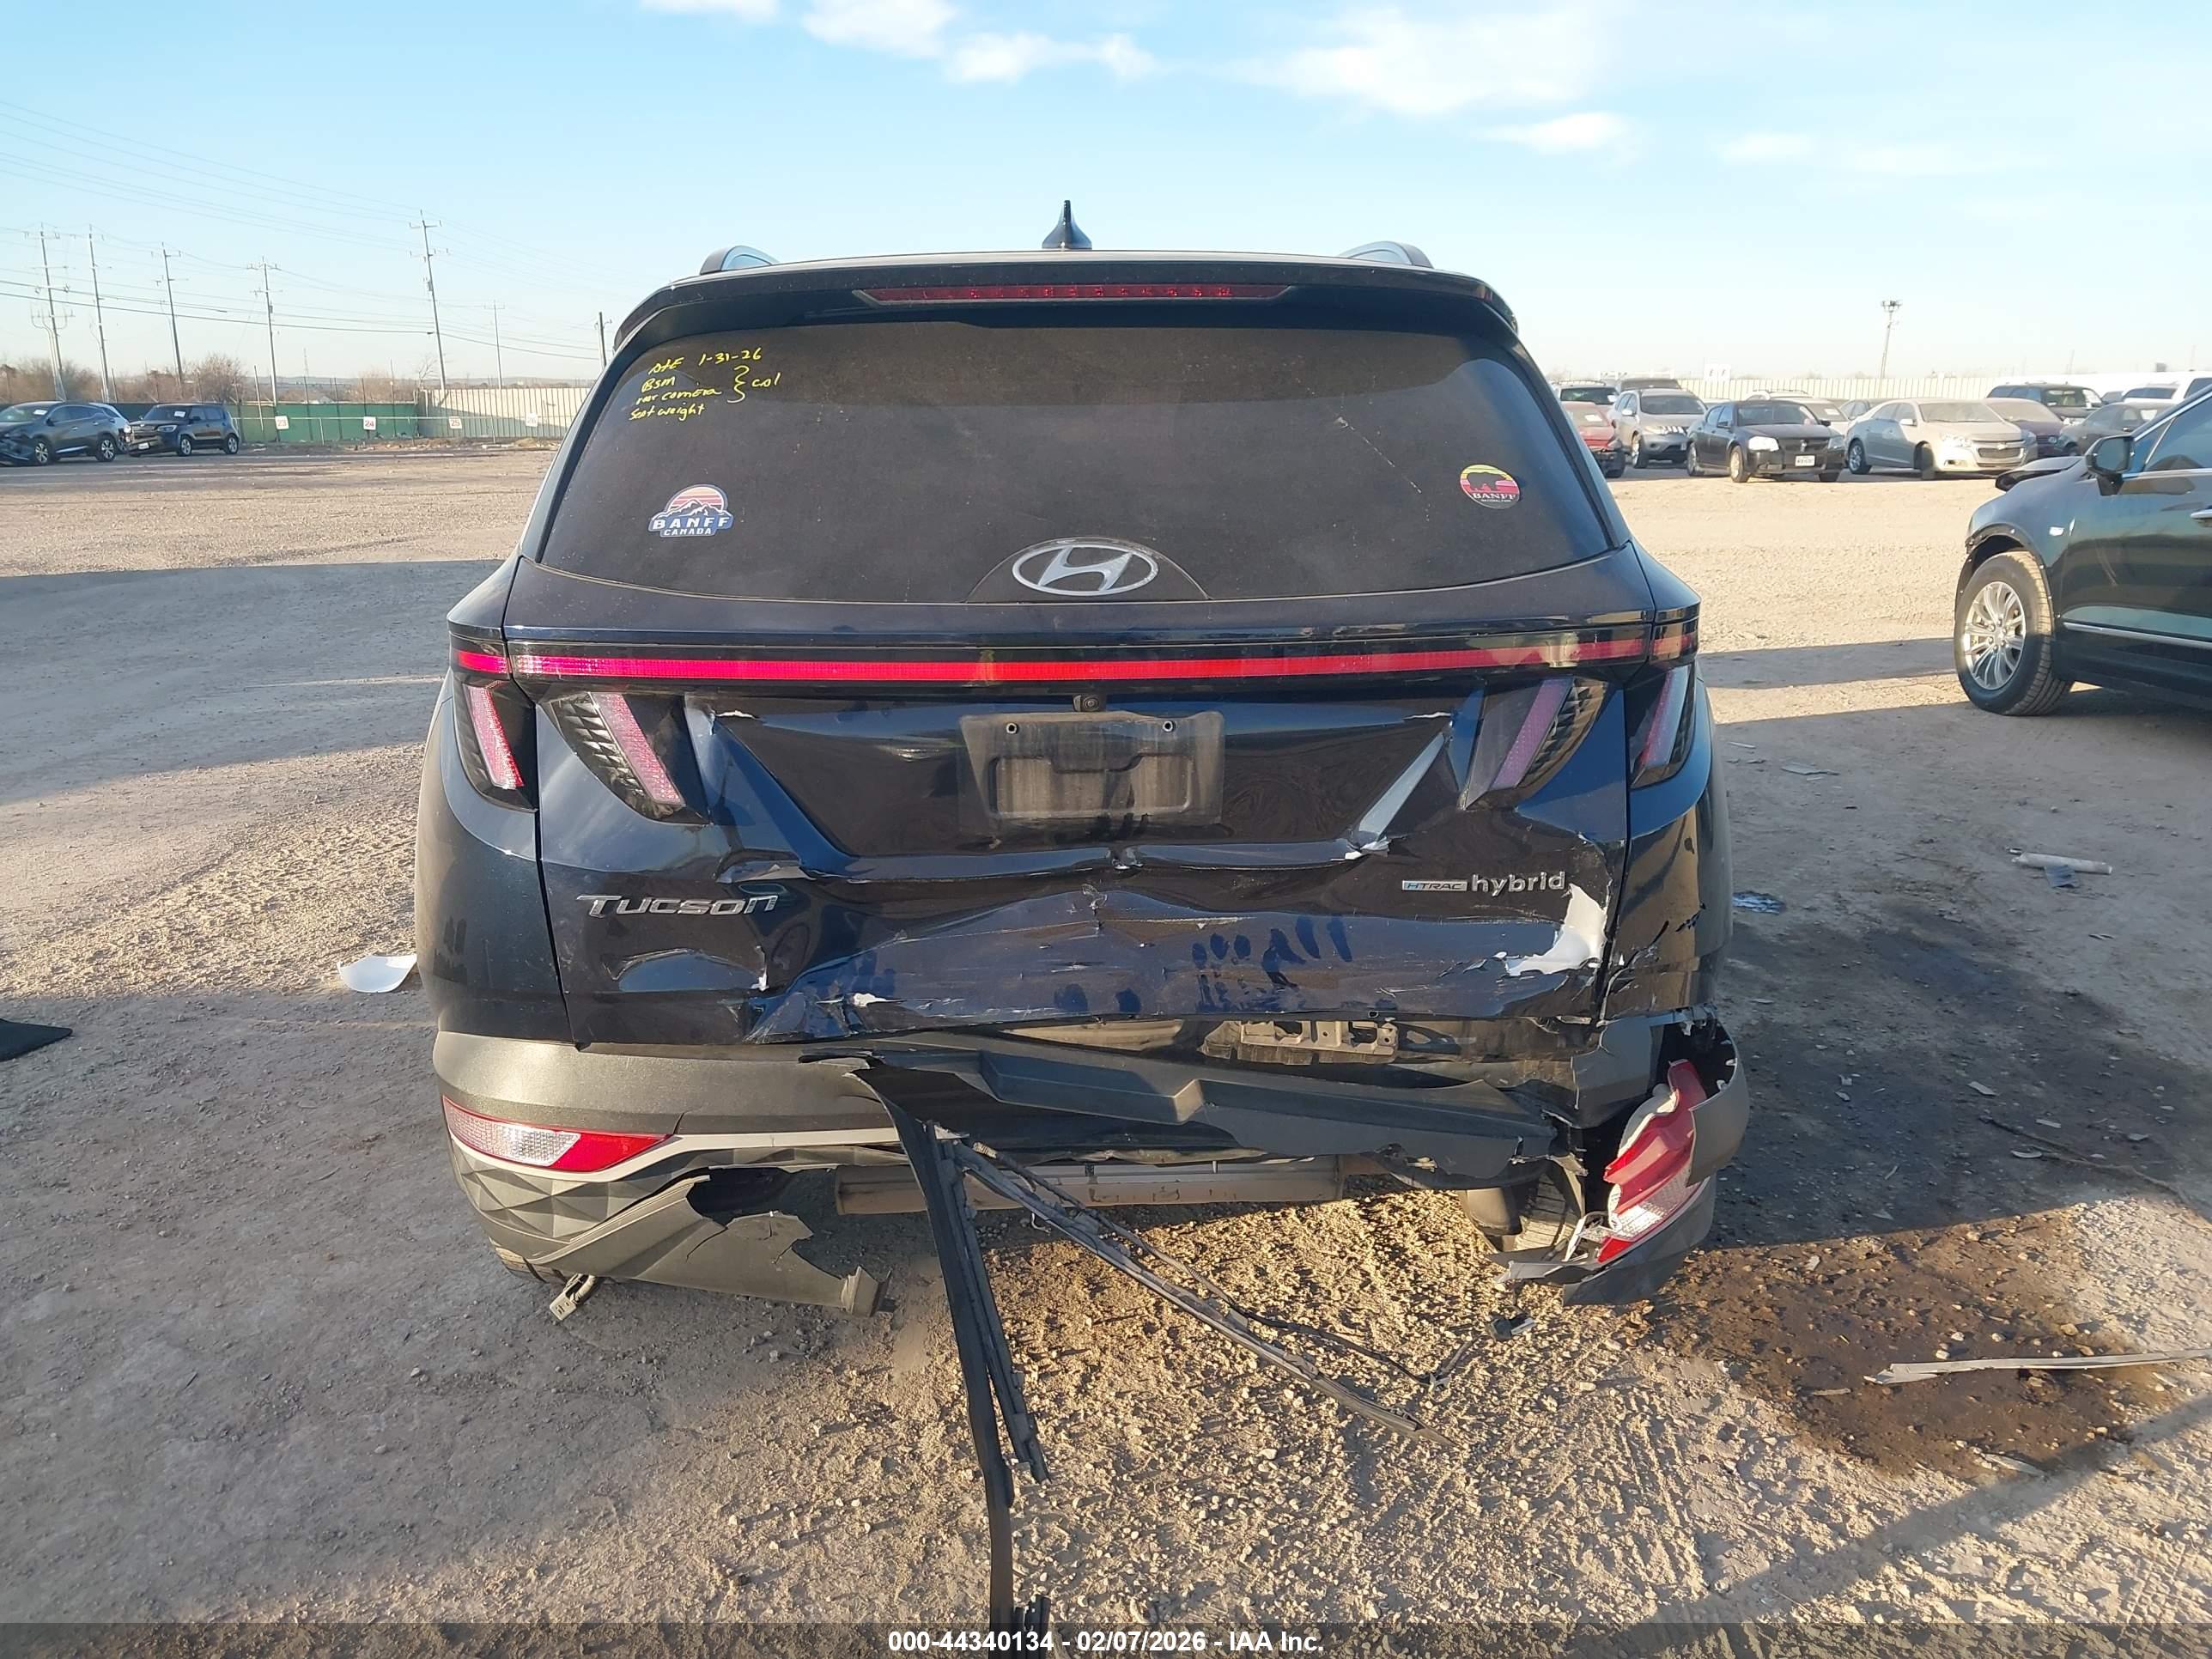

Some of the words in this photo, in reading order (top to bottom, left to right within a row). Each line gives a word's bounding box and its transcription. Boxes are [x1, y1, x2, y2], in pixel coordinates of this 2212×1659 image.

[698, 347, 763, 367] 1-31-26
[653, 517, 730, 530] BANFF
[1472, 871, 1565, 896] hybrid
